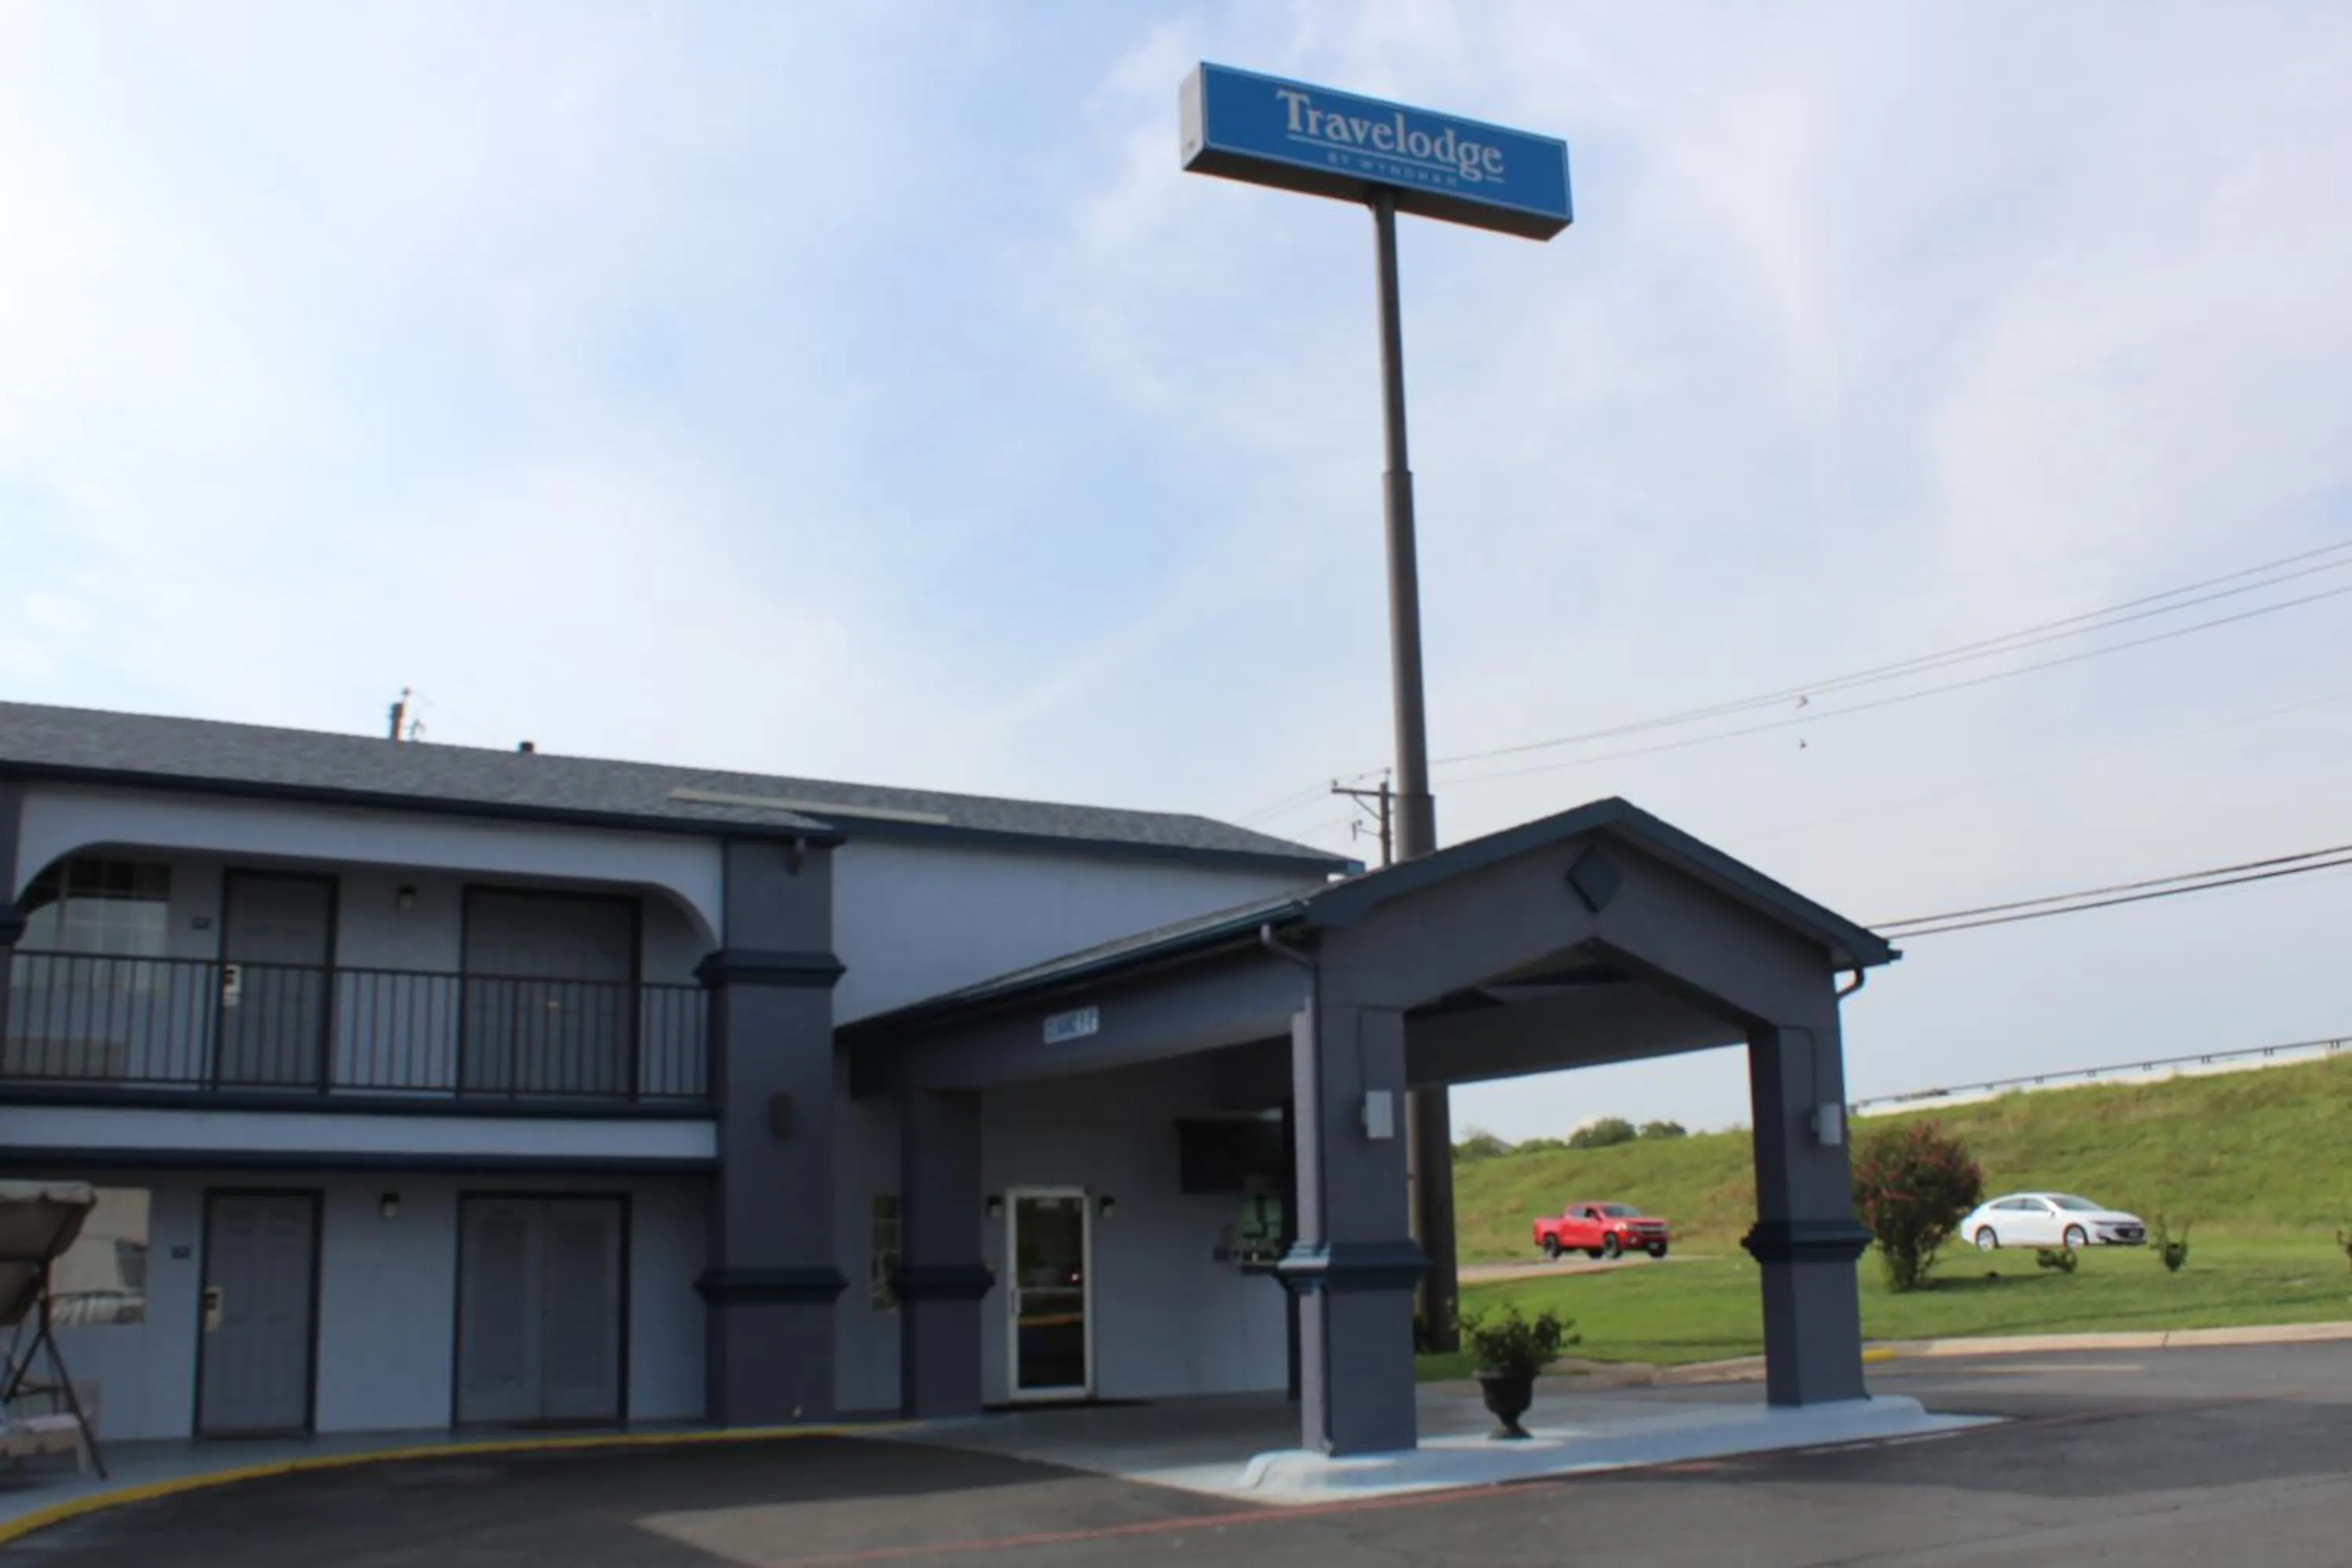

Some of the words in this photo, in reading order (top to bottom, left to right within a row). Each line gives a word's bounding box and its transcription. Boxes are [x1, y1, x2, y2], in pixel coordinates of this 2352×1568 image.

[1276, 89, 1504, 182] Travelodge
[1327, 152, 1350, 165] BY
[1360, 161, 1457, 187] WYNDHAM
